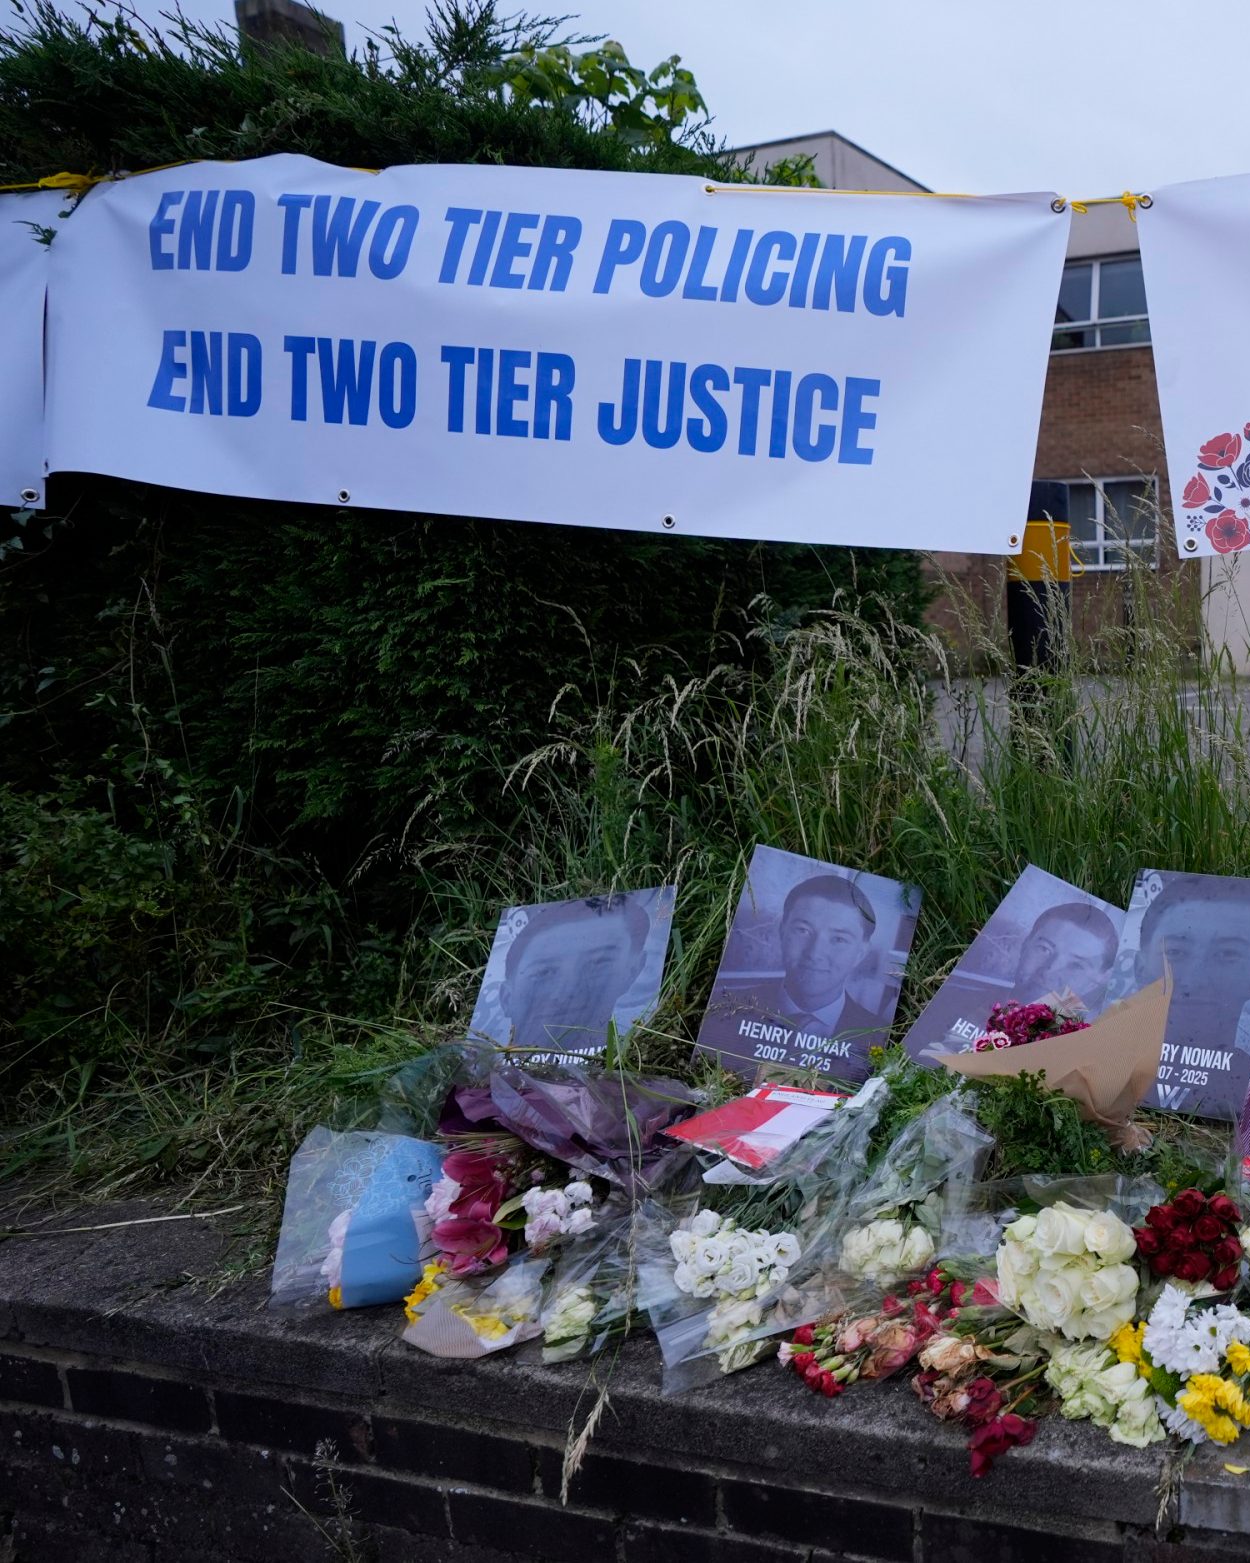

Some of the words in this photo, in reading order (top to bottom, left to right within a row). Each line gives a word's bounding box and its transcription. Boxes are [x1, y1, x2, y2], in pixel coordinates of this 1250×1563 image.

[149, 189, 256, 272] END
[277, 193, 419, 280] TWO
[438, 208, 582, 292] TIER
[592, 219, 911, 318] POLICING
[146, 330, 262, 417] END
[283, 335, 417, 430] TWO
[440, 345, 576, 442] TIER
[597, 358, 881, 466] JUSTICE
[738, 1019, 793, 1045] HENRY
[794, 1031, 851, 1058] NOWAK
[951, 1017, 989, 1041] HEN
[753, 1043, 787, 1063] 2007
[798, 1053, 832, 1072] 2025
[1180, 1046, 1234, 1072] NOWAK
[1157, 1065, 1174, 1080] 07
[1180, 1068, 1209, 1086] 2025
